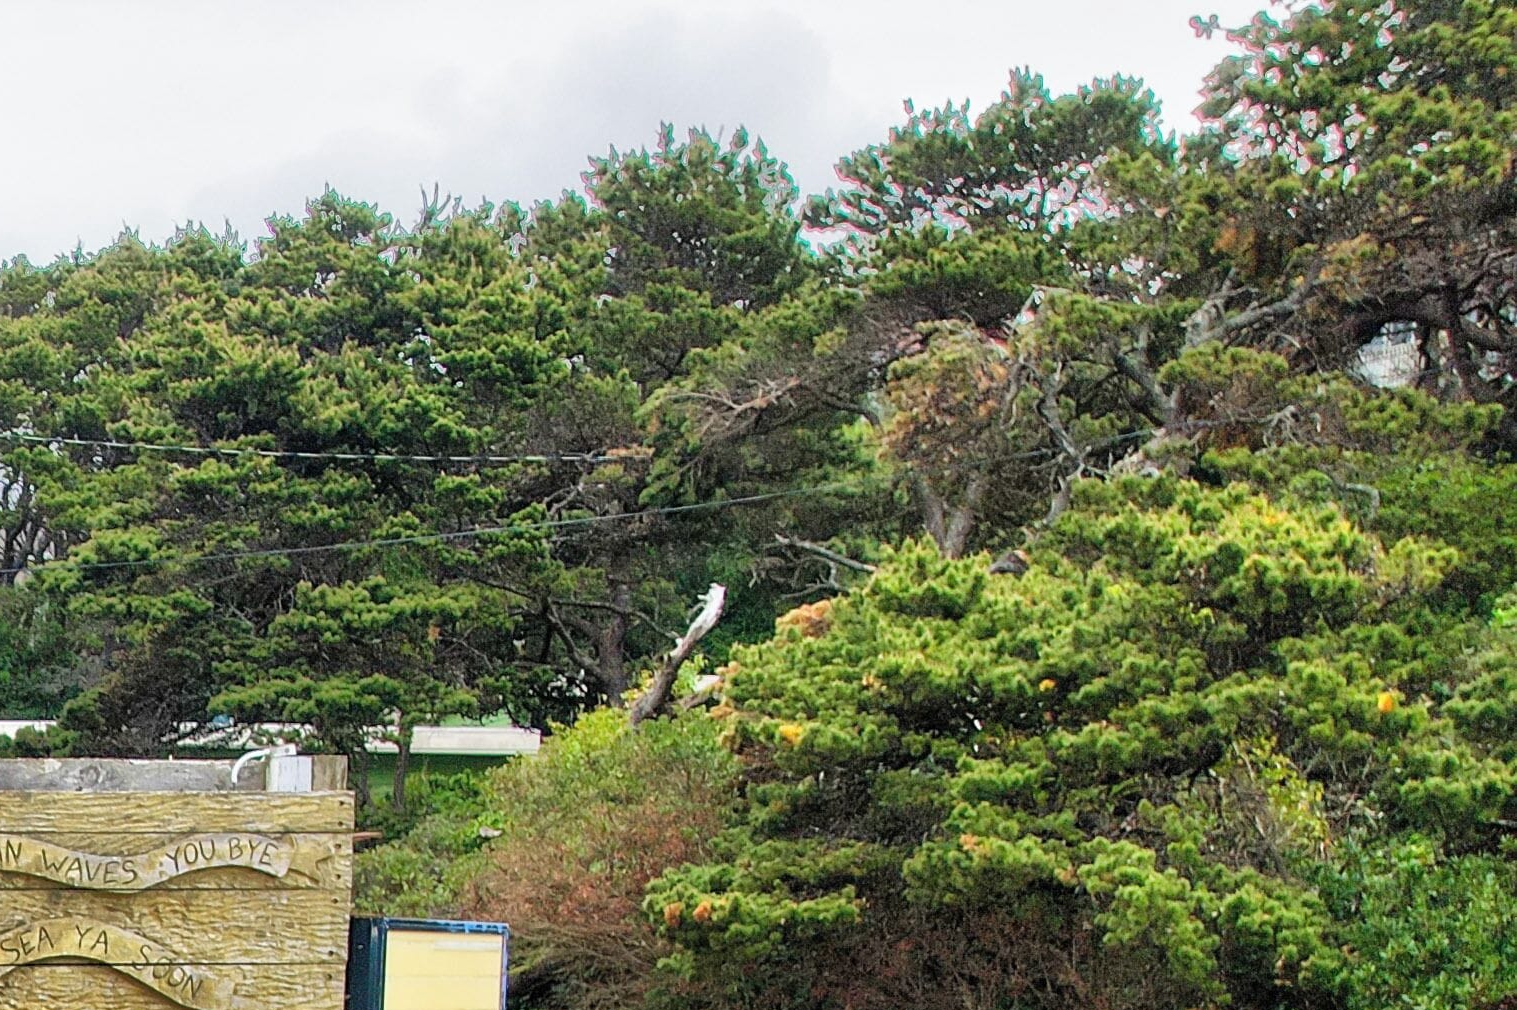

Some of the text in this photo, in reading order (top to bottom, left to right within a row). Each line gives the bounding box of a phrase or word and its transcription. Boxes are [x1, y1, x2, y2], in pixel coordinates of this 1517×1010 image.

[41, 849, 139, 885] WAVES
[165, 839, 216, 872] YOU
[228, 837, 279, 866] BYE
[0, 924, 204, 999] SEA YA SOON
